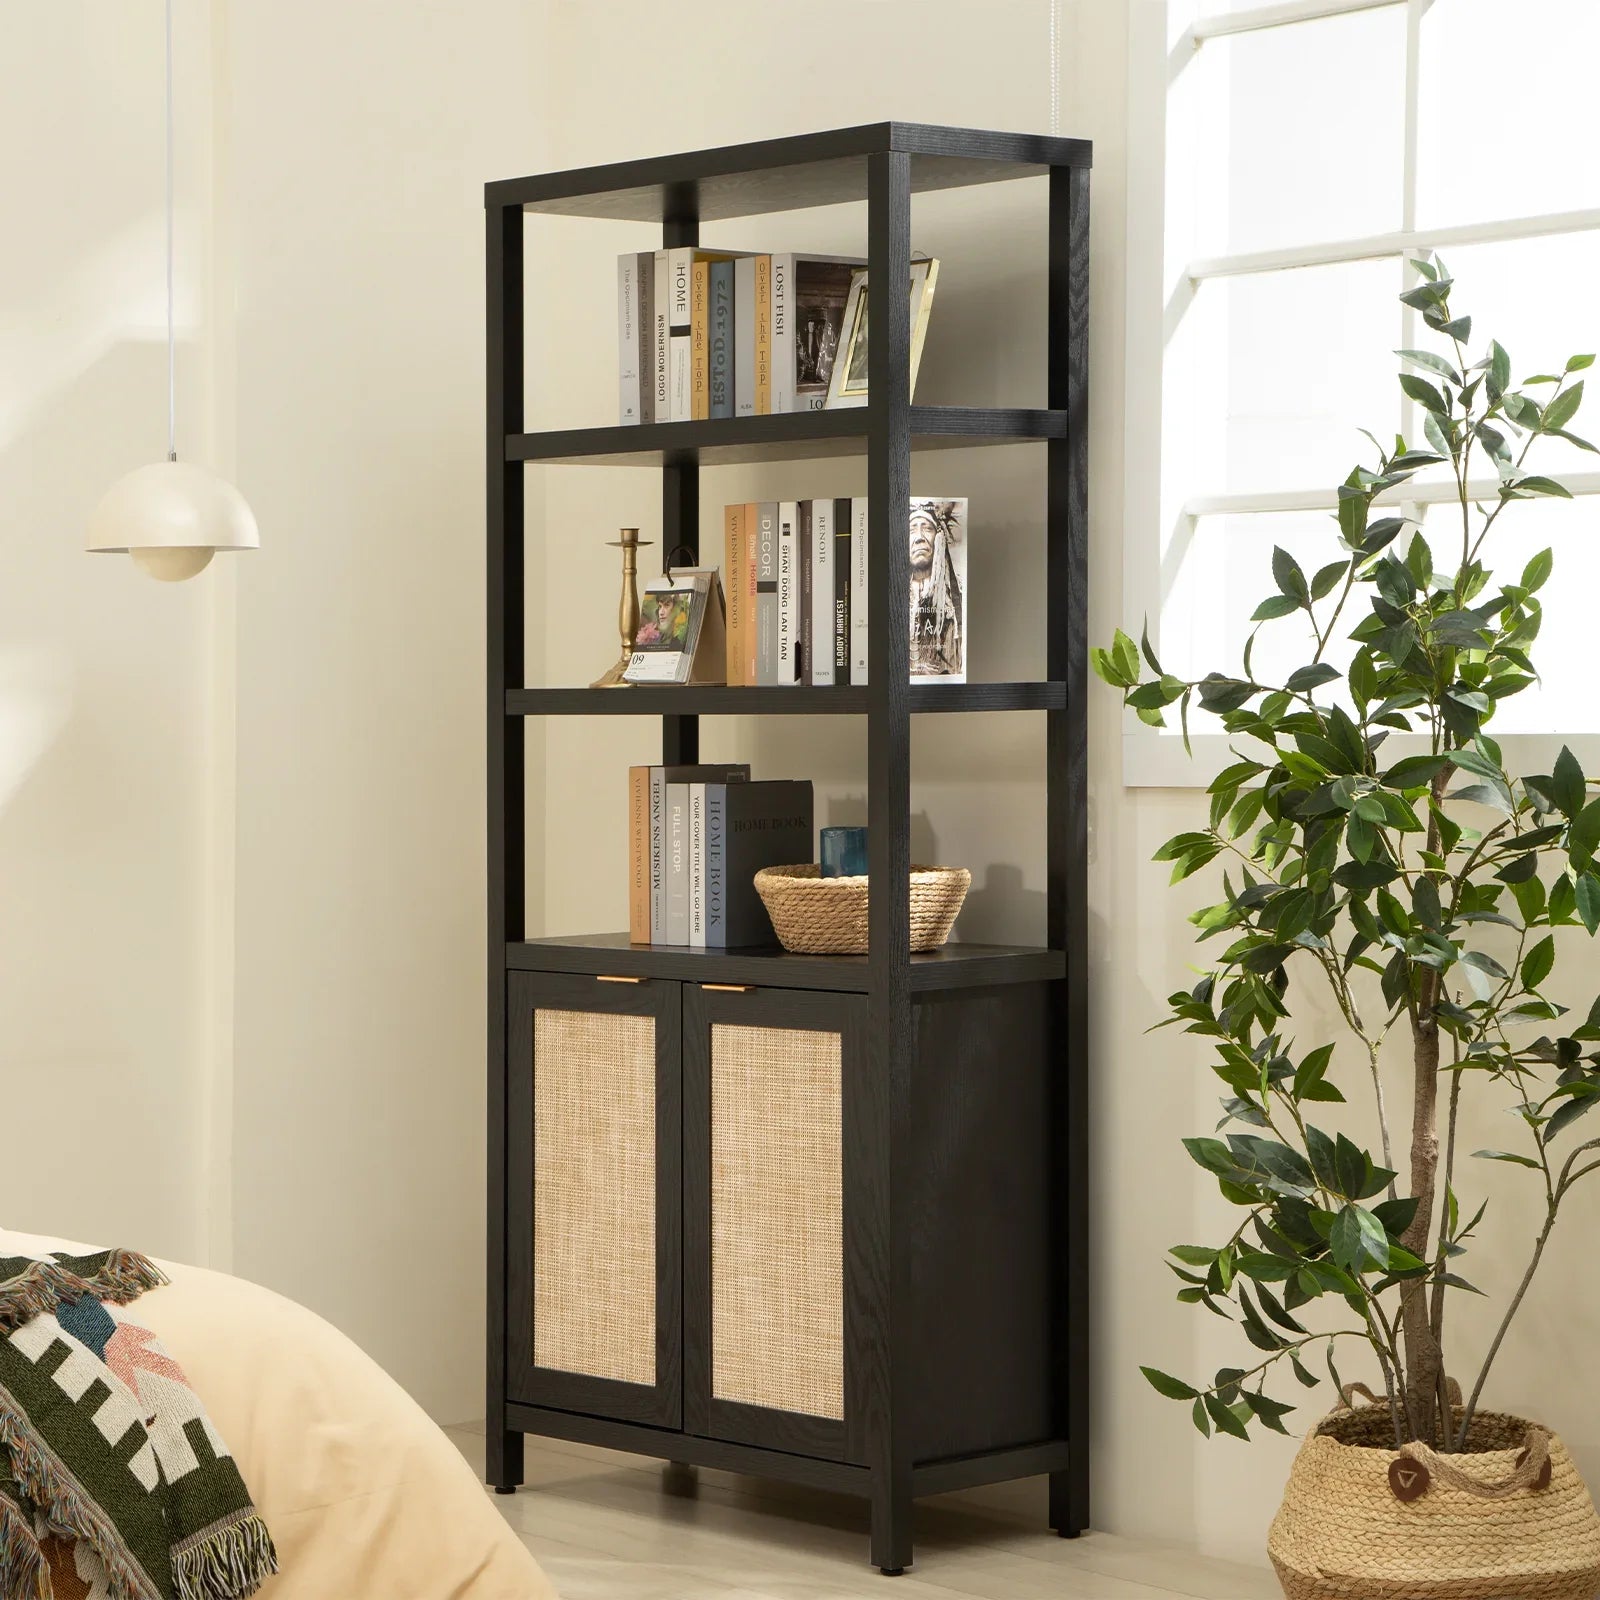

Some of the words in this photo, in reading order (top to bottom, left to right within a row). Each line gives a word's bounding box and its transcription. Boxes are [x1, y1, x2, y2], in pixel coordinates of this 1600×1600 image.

[676, 266, 686, 312] HOME
[694, 271, 704, 312] Over
[758, 263, 767, 304] Over
[775, 265, 784, 301] LOST
[694, 320, 704, 351] the
[758, 312, 768, 344] the
[775, 304, 784, 336] FISH
[809, 399, 824, 410] LO
[761, 519, 772, 577] DECOR
[818, 516, 826, 564] RENOIR
[836, 599, 844, 634] HARVEST
[632, 654, 645, 665] 09
[836, 635, 844, 667] BLOODY
[672, 805, 681, 836] FULL
[710, 800, 721, 863] HOME
[635, 828, 643, 888] WESTWOOD
[653, 825, 661, 890] MUSIKENS
[694, 896, 700, 910] GO
[710, 867, 721, 926] BOOK
